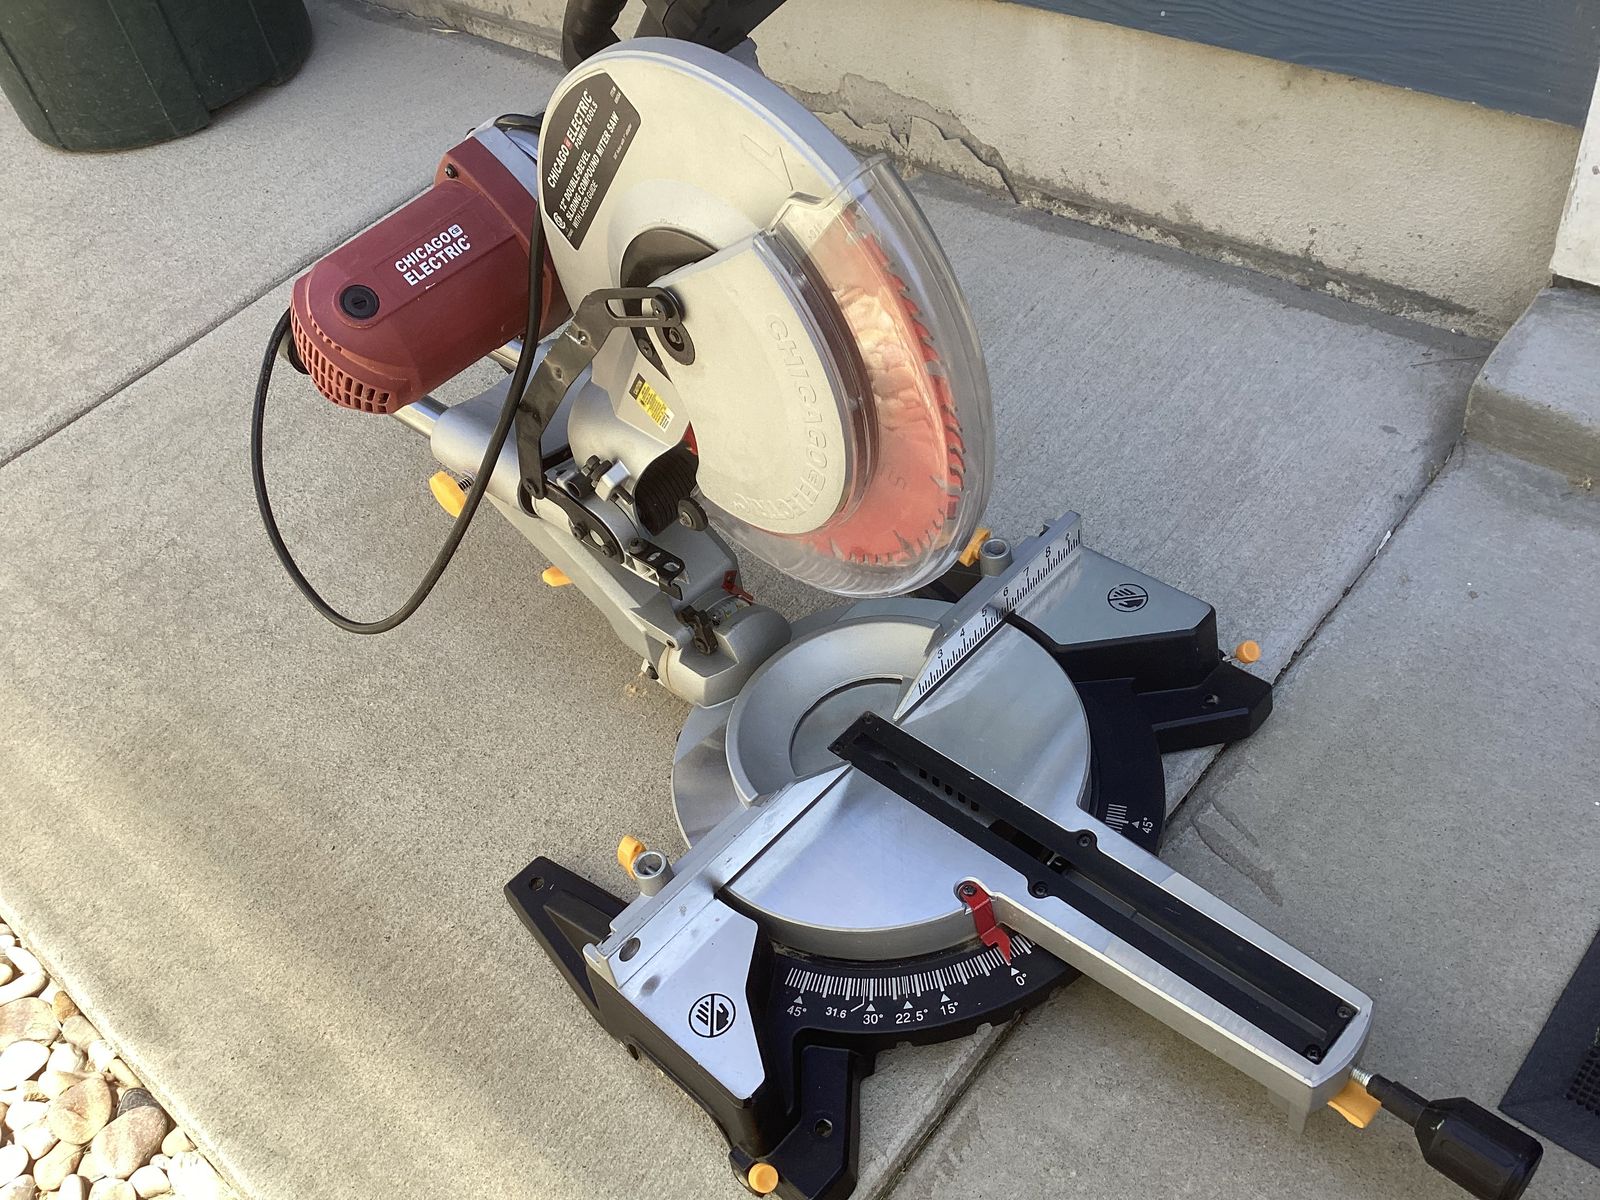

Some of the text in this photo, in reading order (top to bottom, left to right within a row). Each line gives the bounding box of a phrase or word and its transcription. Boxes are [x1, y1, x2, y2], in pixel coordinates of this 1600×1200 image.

[547, 144, 570, 188] CHICAGO
[566, 89, 594, 144] ELECTRIC
[574, 102, 598, 150] POWER TOOLS
[564, 149, 591, 201] DOUBLE-BEVEL
[565, 193, 582, 222] SLIDING
[578, 153, 600, 196] COMPOUND
[595, 131, 611, 157] MITER
[607, 111, 620, 131] SAW
[572, 180, 598, 229] WITH LASER GUIDE
[395, 232, 451, 272] CHICAGO
[403, 237, 471, 286] ELECTRIC
[768, 314, 828, 470] CHICAGO
[937, 648, 943, 659] 3
[960, 628, 965, 637] 4
[981, 607, 987, 617] 5
[1002, 586, 1009, 596] 6
[1023, 567, 1030, 577] 7
[1045, 546, 1051, 558] 8
[1142, 817, 1154, 834] 45°
[786, 973, 1028, 1025] 45° 31.6 30° 22.5° 15° 0°
